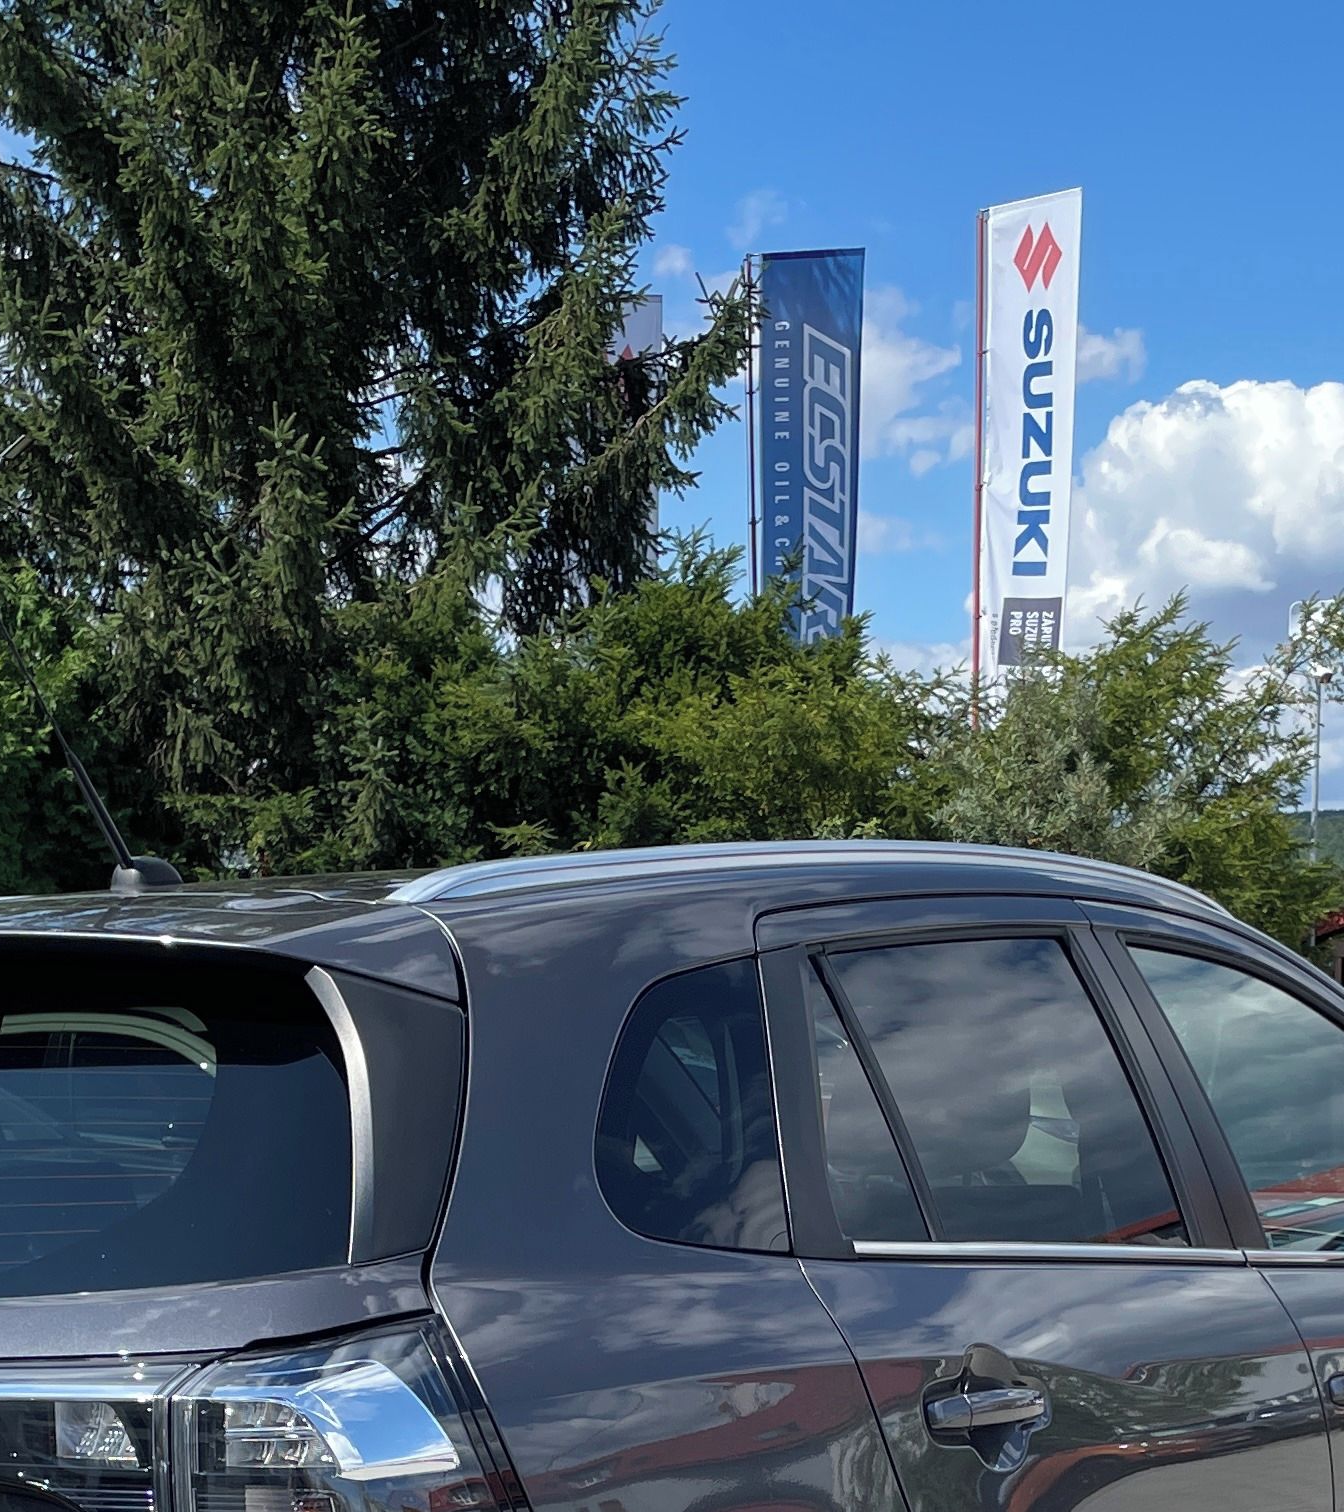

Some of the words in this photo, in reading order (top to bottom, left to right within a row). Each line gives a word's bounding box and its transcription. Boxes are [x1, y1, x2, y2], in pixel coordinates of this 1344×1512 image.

[774, 320, 790, 440] GENUINE
[1011, 308, 1054, 577] SUZUKI
[774, 461, 790, 504] OIL
[774, 515, 790, 527] &
[1008, 611, 1023, 635] PRO
